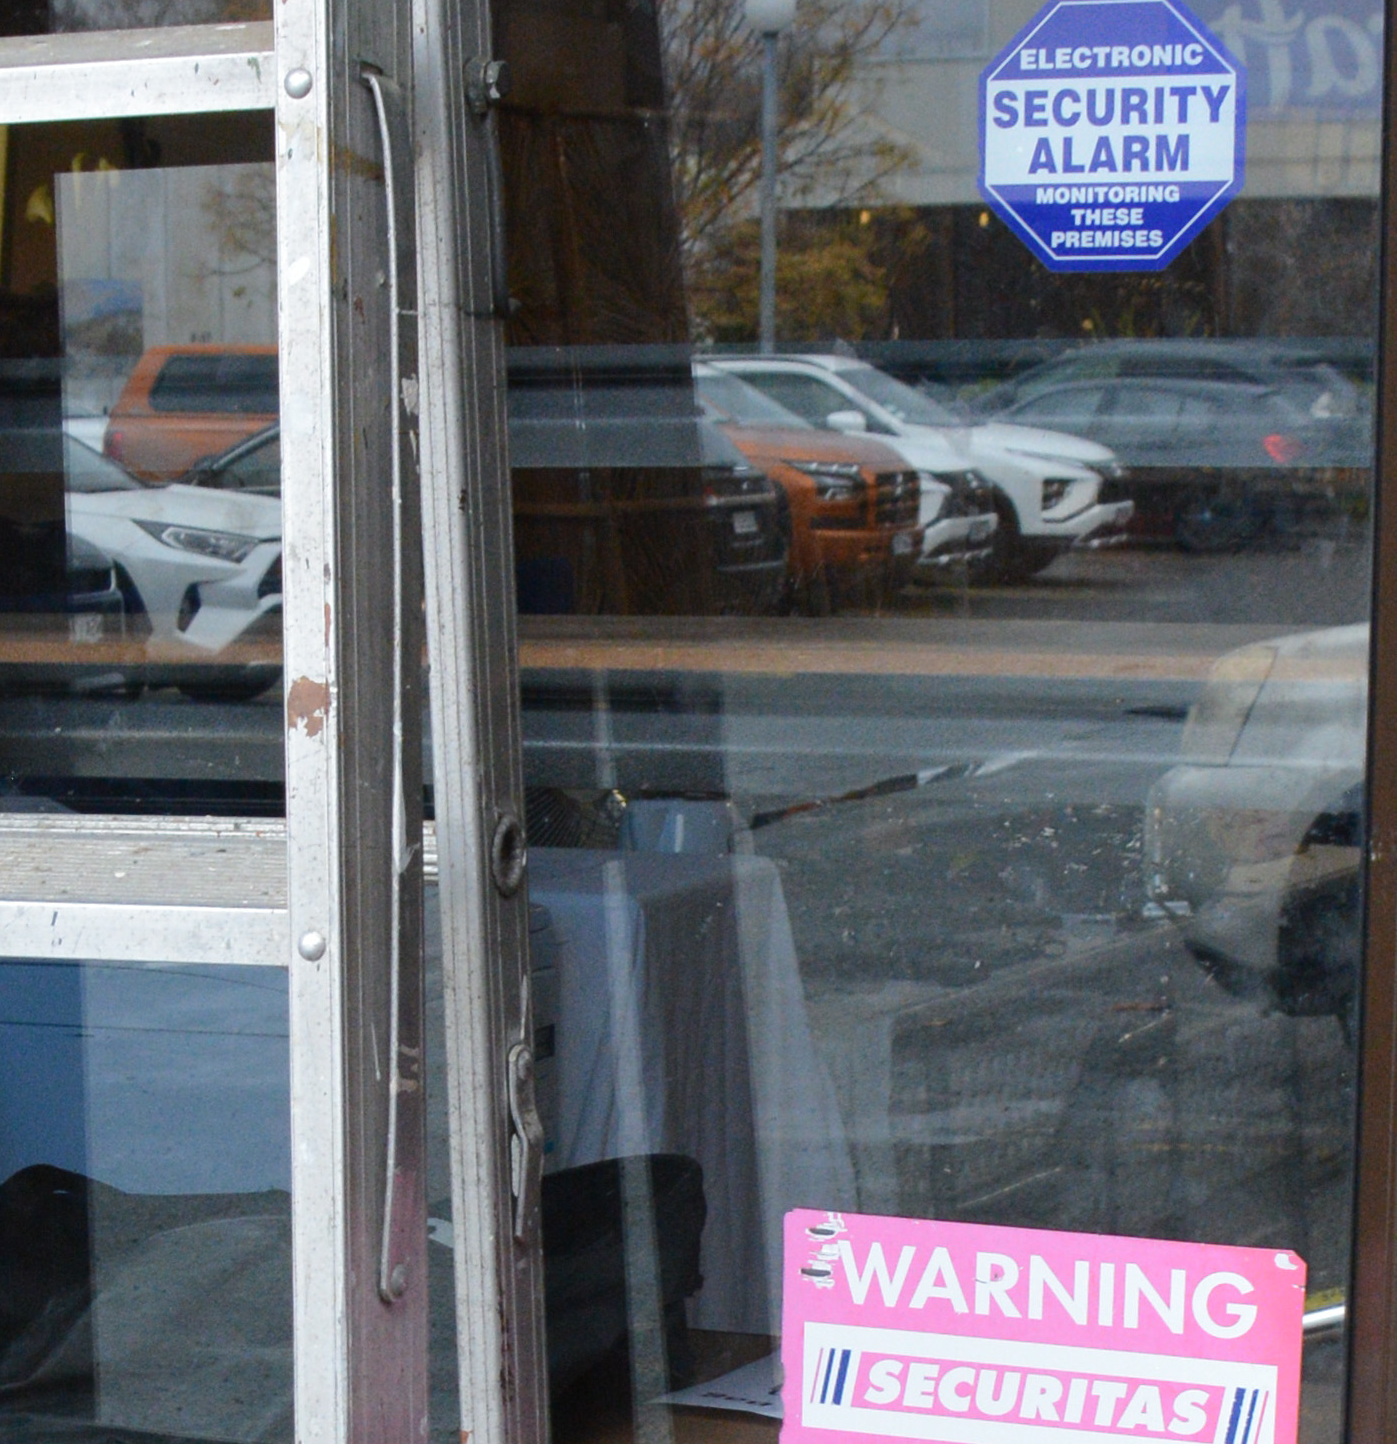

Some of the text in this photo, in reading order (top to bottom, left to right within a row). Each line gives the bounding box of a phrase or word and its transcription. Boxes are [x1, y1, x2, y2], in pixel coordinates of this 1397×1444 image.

[1019, 43, 1203, 70] ELECTRONIC
[992, 84, 1232, 129] SECURITY
[1027, 134, 1191, 175] ALARM
[1035, 186, 1180, 205] MONITORING
[1071, 208, 1144, 226] THESE
[1051, 230, 1164, 249] PREMISES
[838, 1239, 1259, 1340] WARNING
[863, 1359, 1211, 1436] SECURITAS
